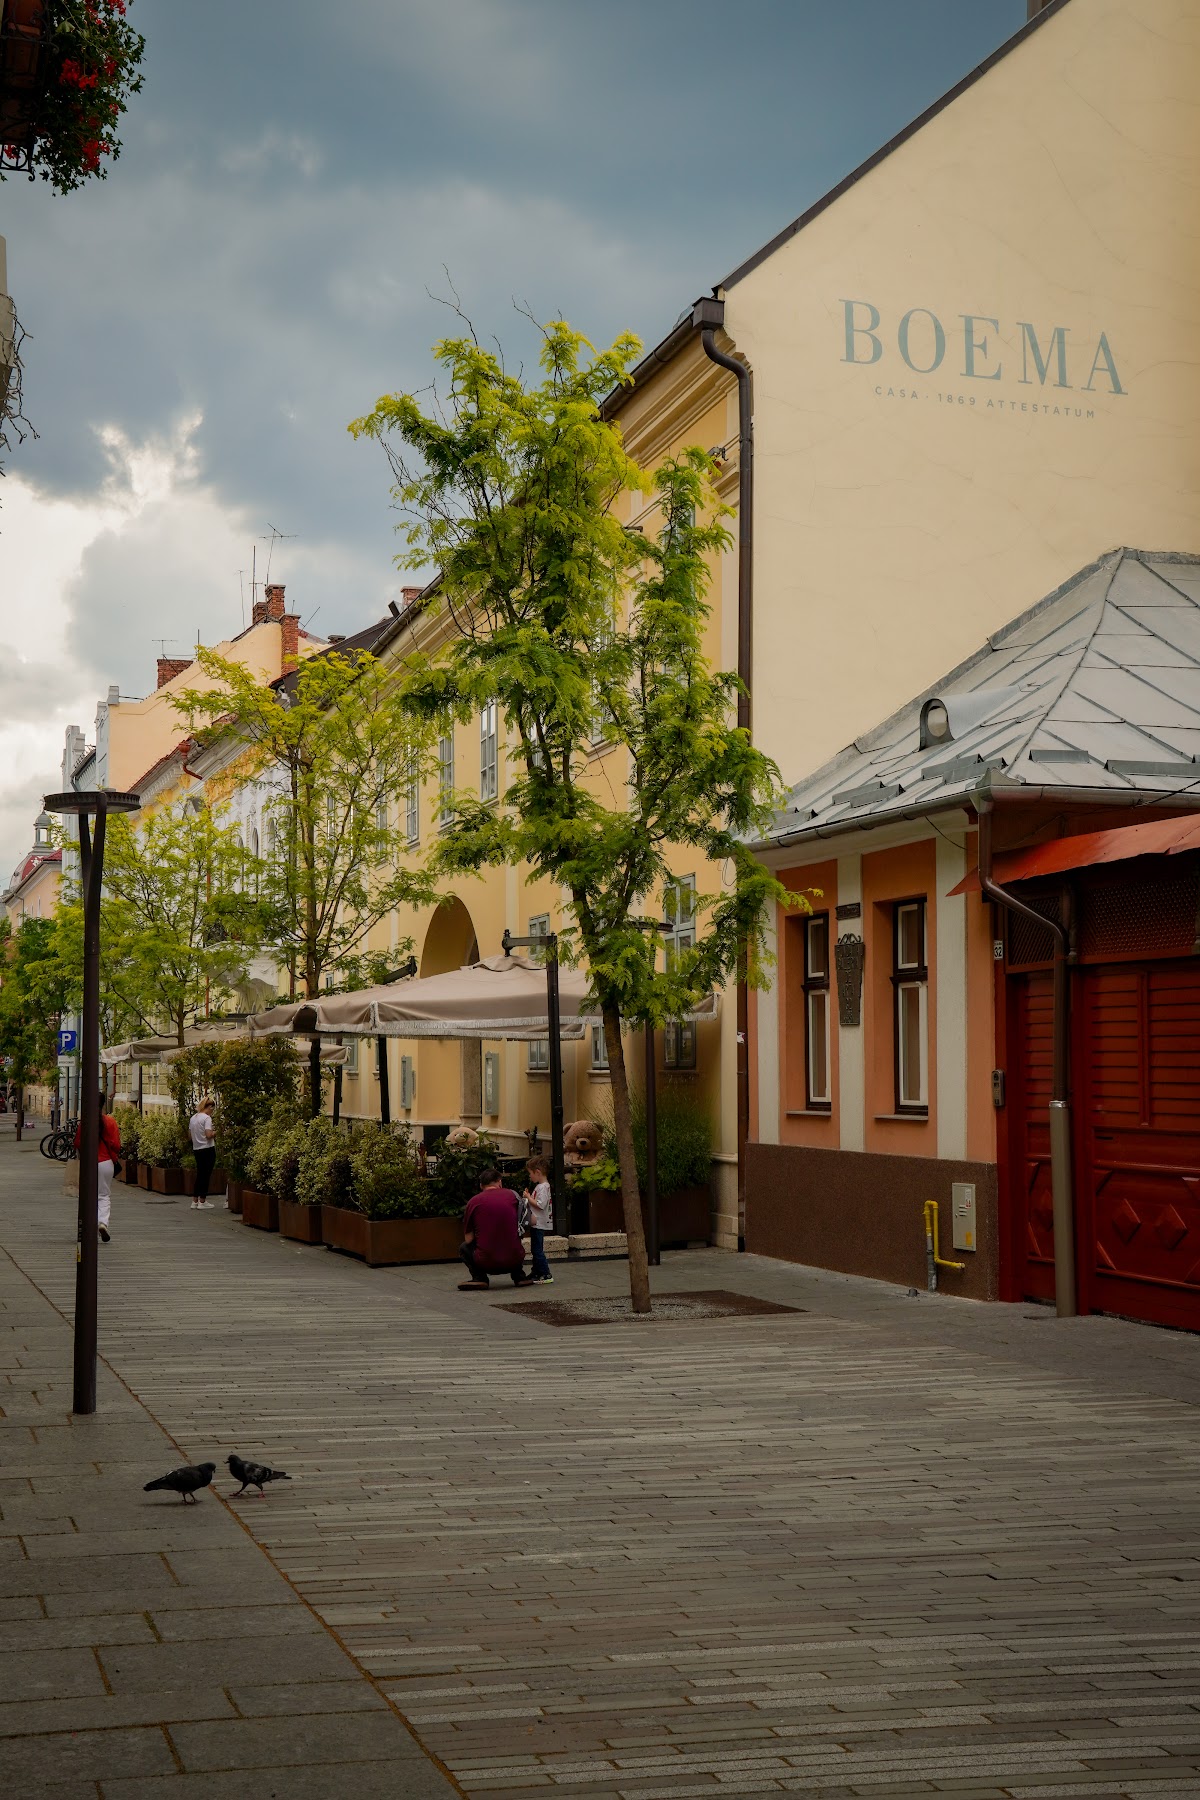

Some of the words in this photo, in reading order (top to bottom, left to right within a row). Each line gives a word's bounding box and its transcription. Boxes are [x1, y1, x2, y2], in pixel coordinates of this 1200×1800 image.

[838, 298, 1129, 395] BOEMA
[875, 386, 919, 400] CASA
[938, 393, 977, 406] 1869
[987, 399, 1095, 418] ATTESTATUM
[994, 946, 1002, 957] 32
[62, 1033, 72, 1047] P
